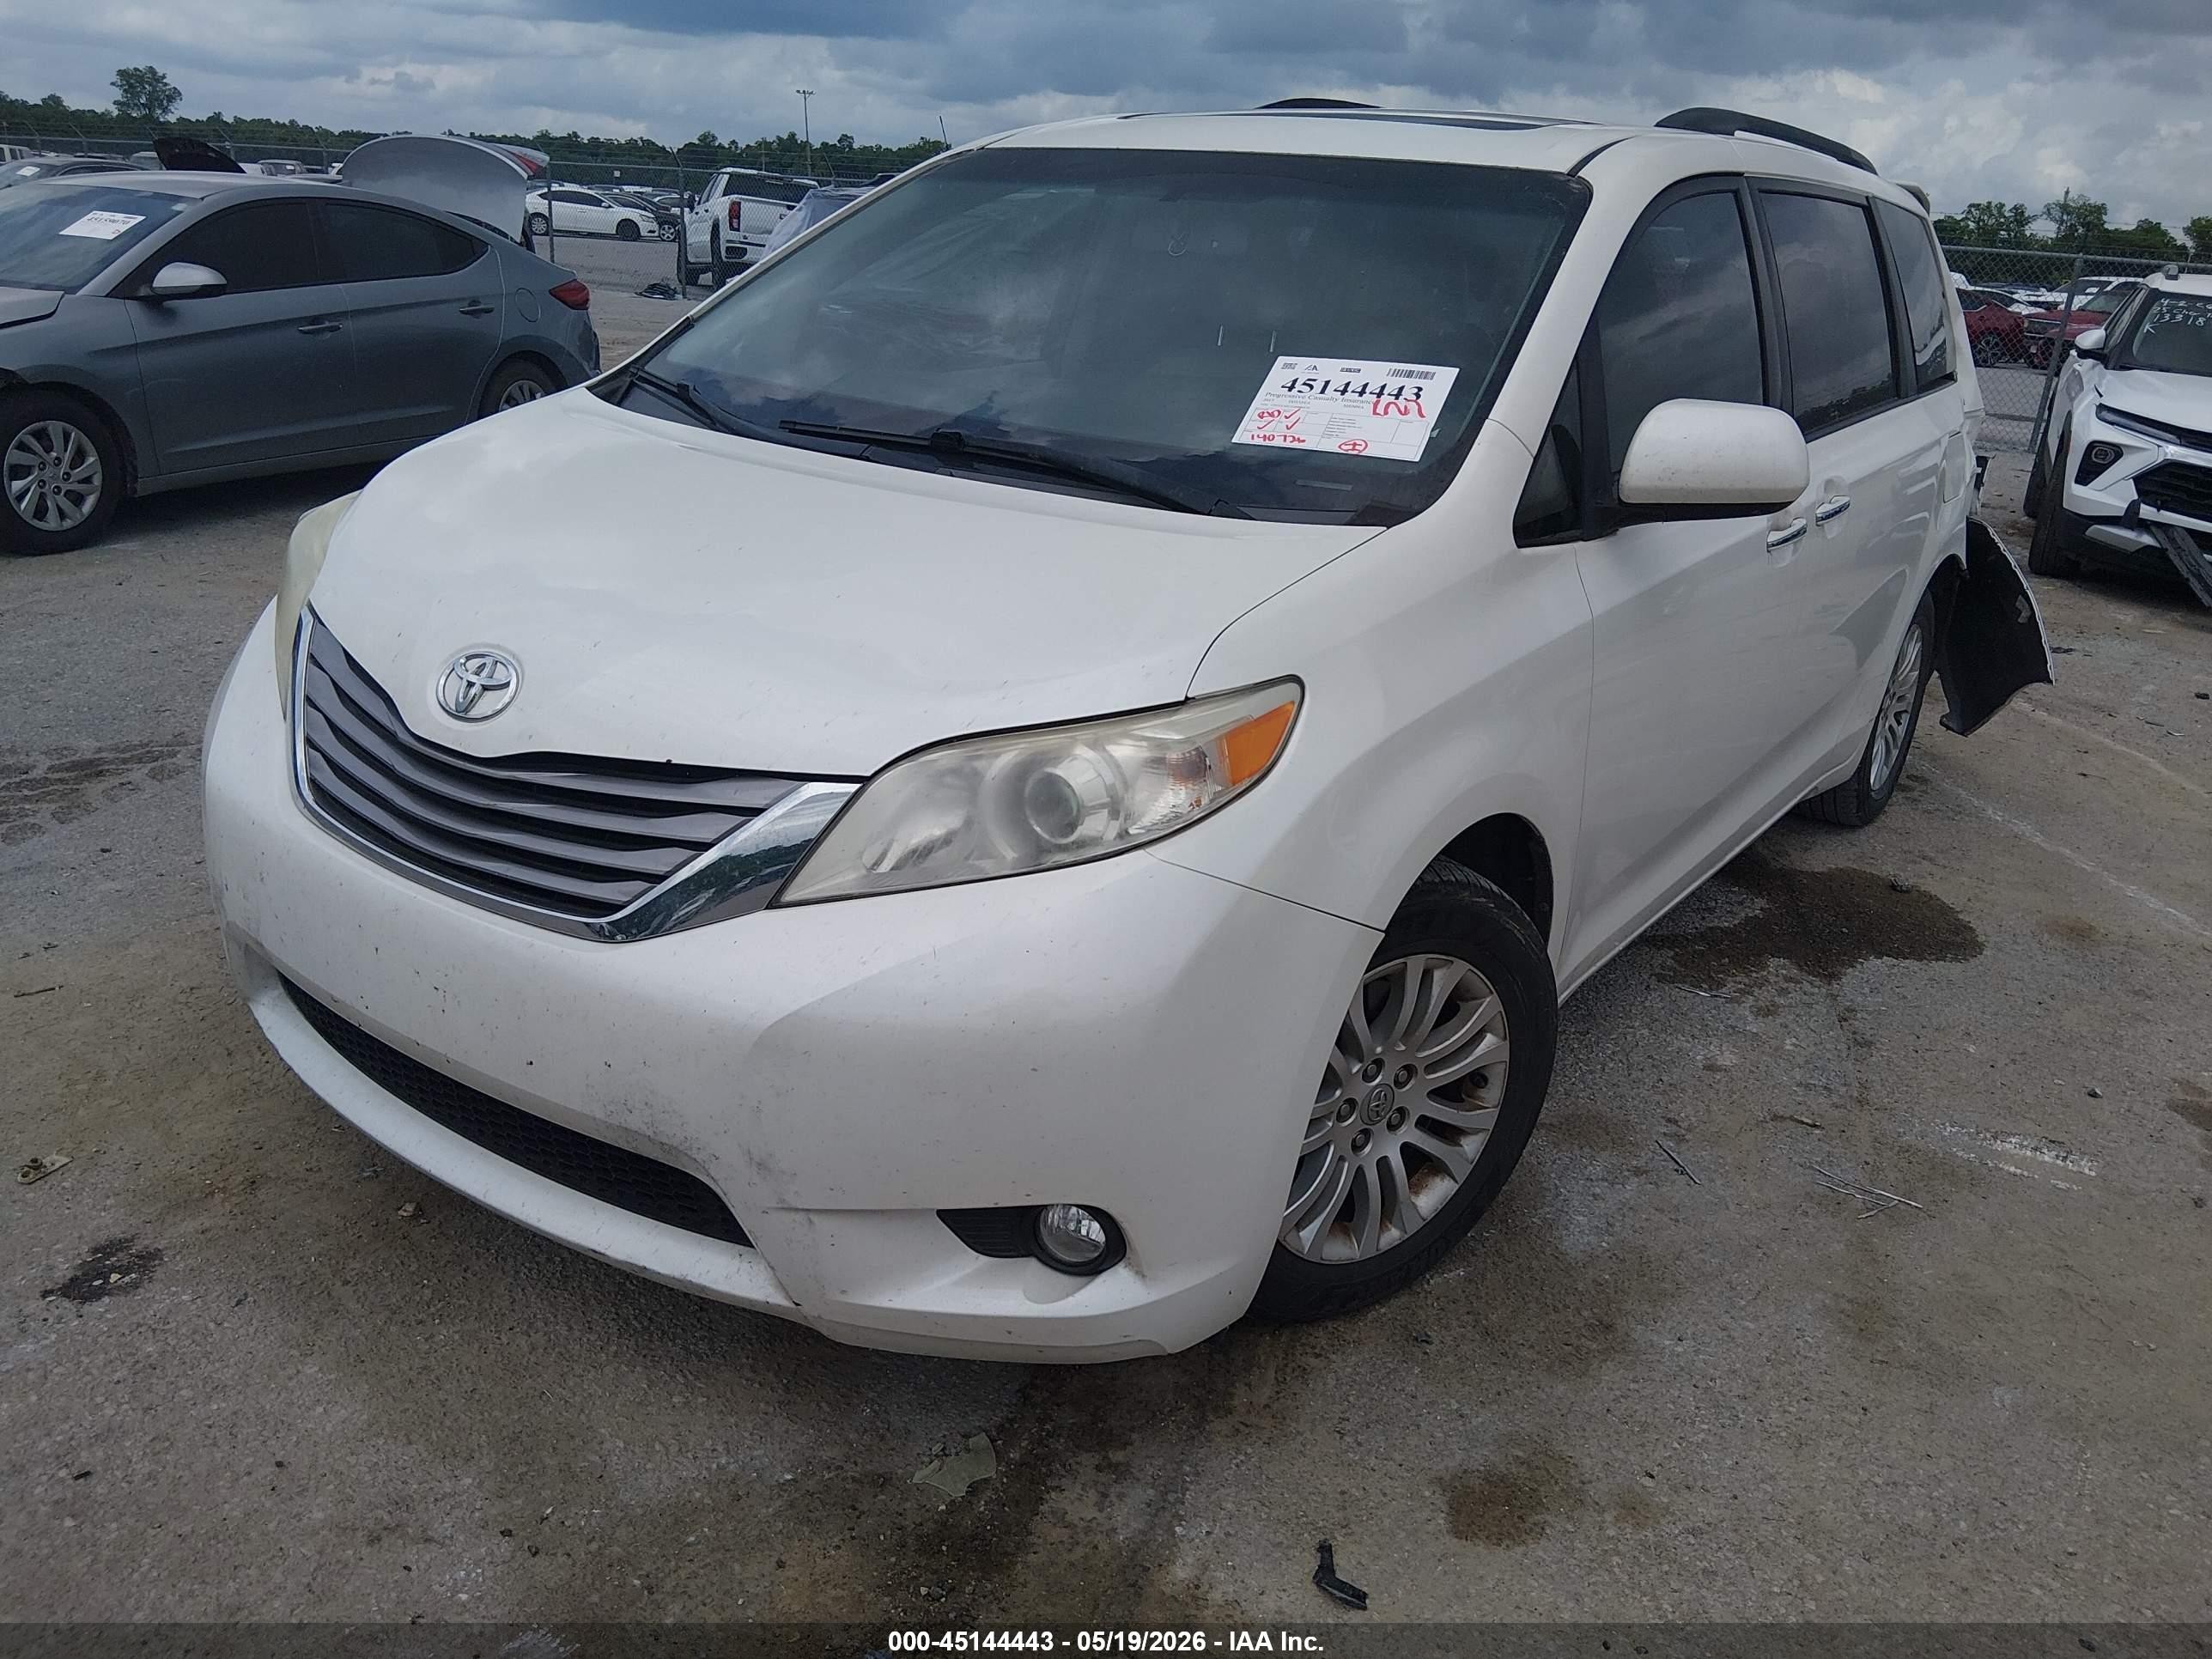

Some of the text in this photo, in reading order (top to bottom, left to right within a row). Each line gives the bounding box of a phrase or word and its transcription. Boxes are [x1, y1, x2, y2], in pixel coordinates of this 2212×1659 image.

[2153, 313, 2207, 326] 13318
[2143, 322, 2160, 334] K
[1280, 377, 1423, 401] 45144443
[1266, 392, 1306, 400] Progressive
[1308, 394, 1340, 403] Casualty
